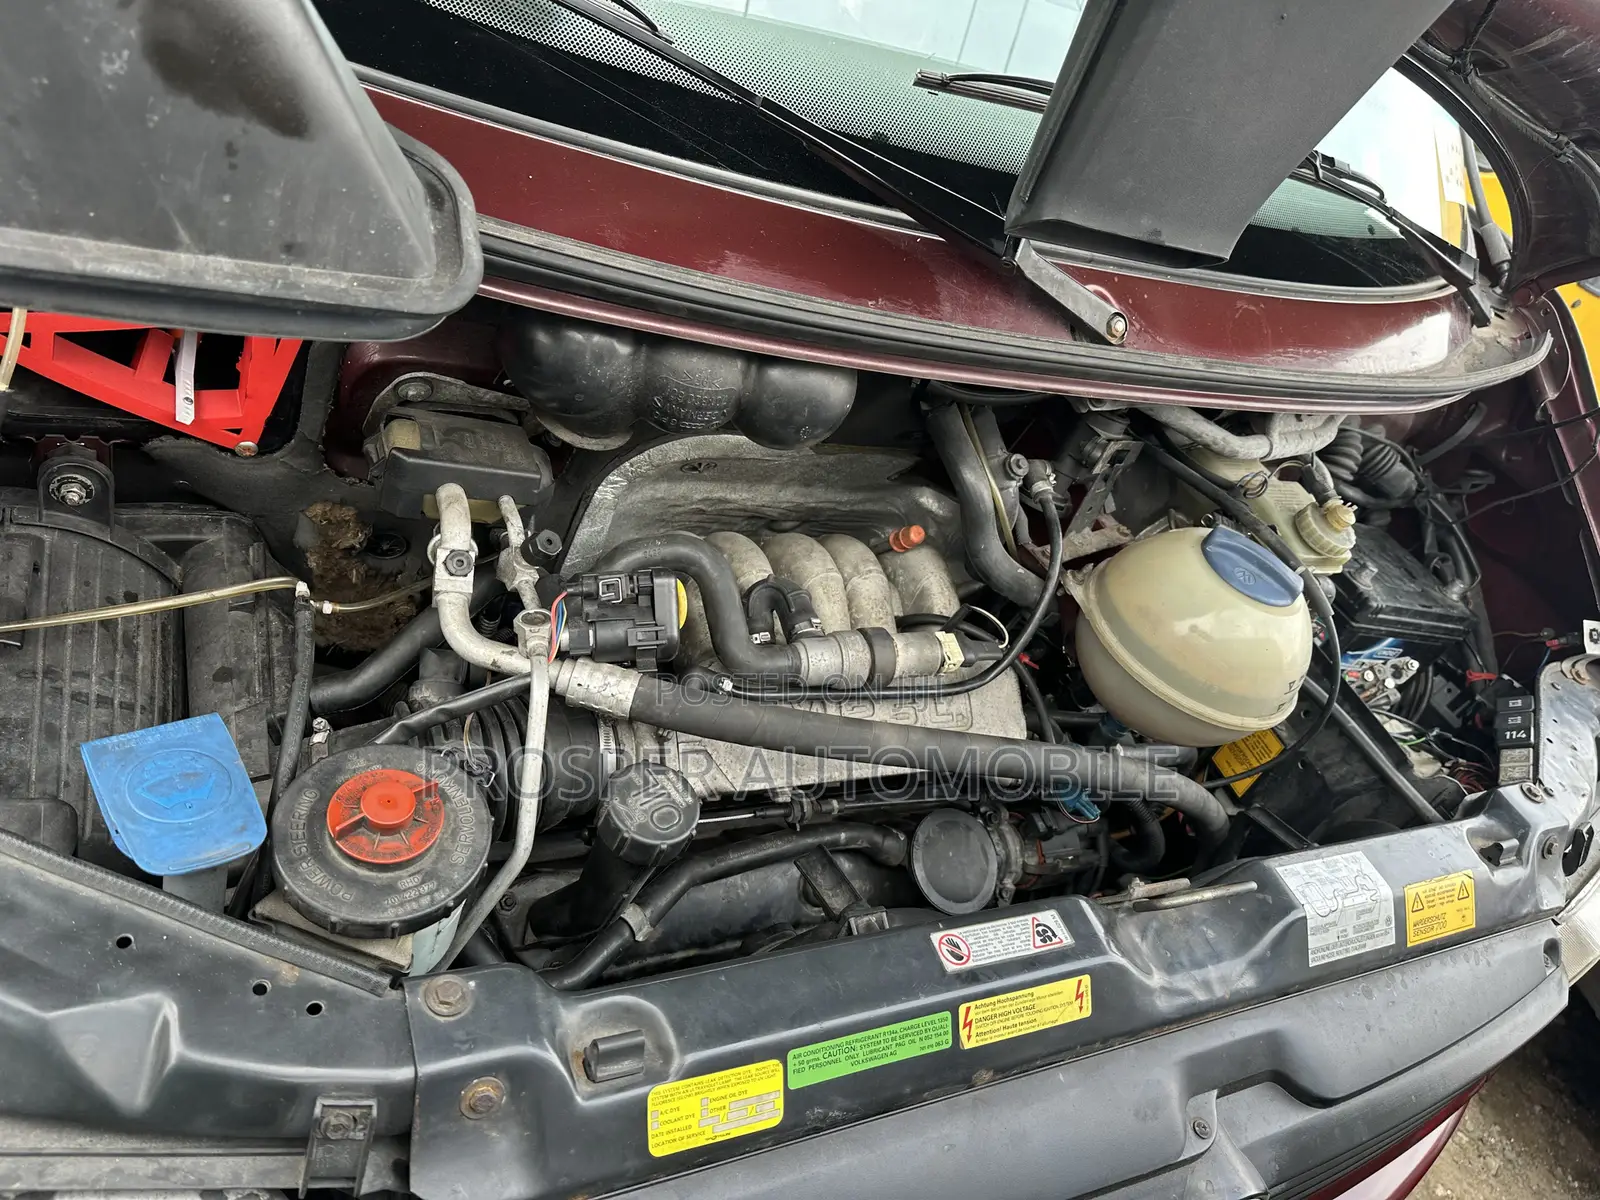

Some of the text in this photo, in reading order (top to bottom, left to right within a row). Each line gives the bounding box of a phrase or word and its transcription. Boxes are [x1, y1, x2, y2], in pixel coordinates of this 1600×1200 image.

[1504, 730, 1526, 740] 114
[299, 857, 355, 900] POWER
[975, 1004, 1036, 1024] DANGER HIGH VOLTAGE
[803, 1042, 844, 1057] CONDITIONING
[845, 1032, 882, 1046] REFRIGERANT
[900, 1024, 920, 1032] CHARGE
[822, 1046, 858, 1060] CAUTION:
[860, 1040, 882, 1050] SYSTEM
[898, 1030, 924, 1040] SERVICED
[808, 1058, 842, 1071] PERSONNEL
[844, 1052, 860, 1061] ONLY
[862, 1044, 892, 1056] LUBRICANT
[850, 1052, 888, 1067] VOLKSWAGEN
[710, 1094, 727, 1104] ENGINE
[710, 1105, 726, 1114] OTHER
[660, 1116, 684, 1126] COOLANT
[651, 1124, 692, 1140] DATE INSTALLED
[652, 1138, 677, 1148] LOCATION
[686, 1130, 706, 1139] SERVICE
